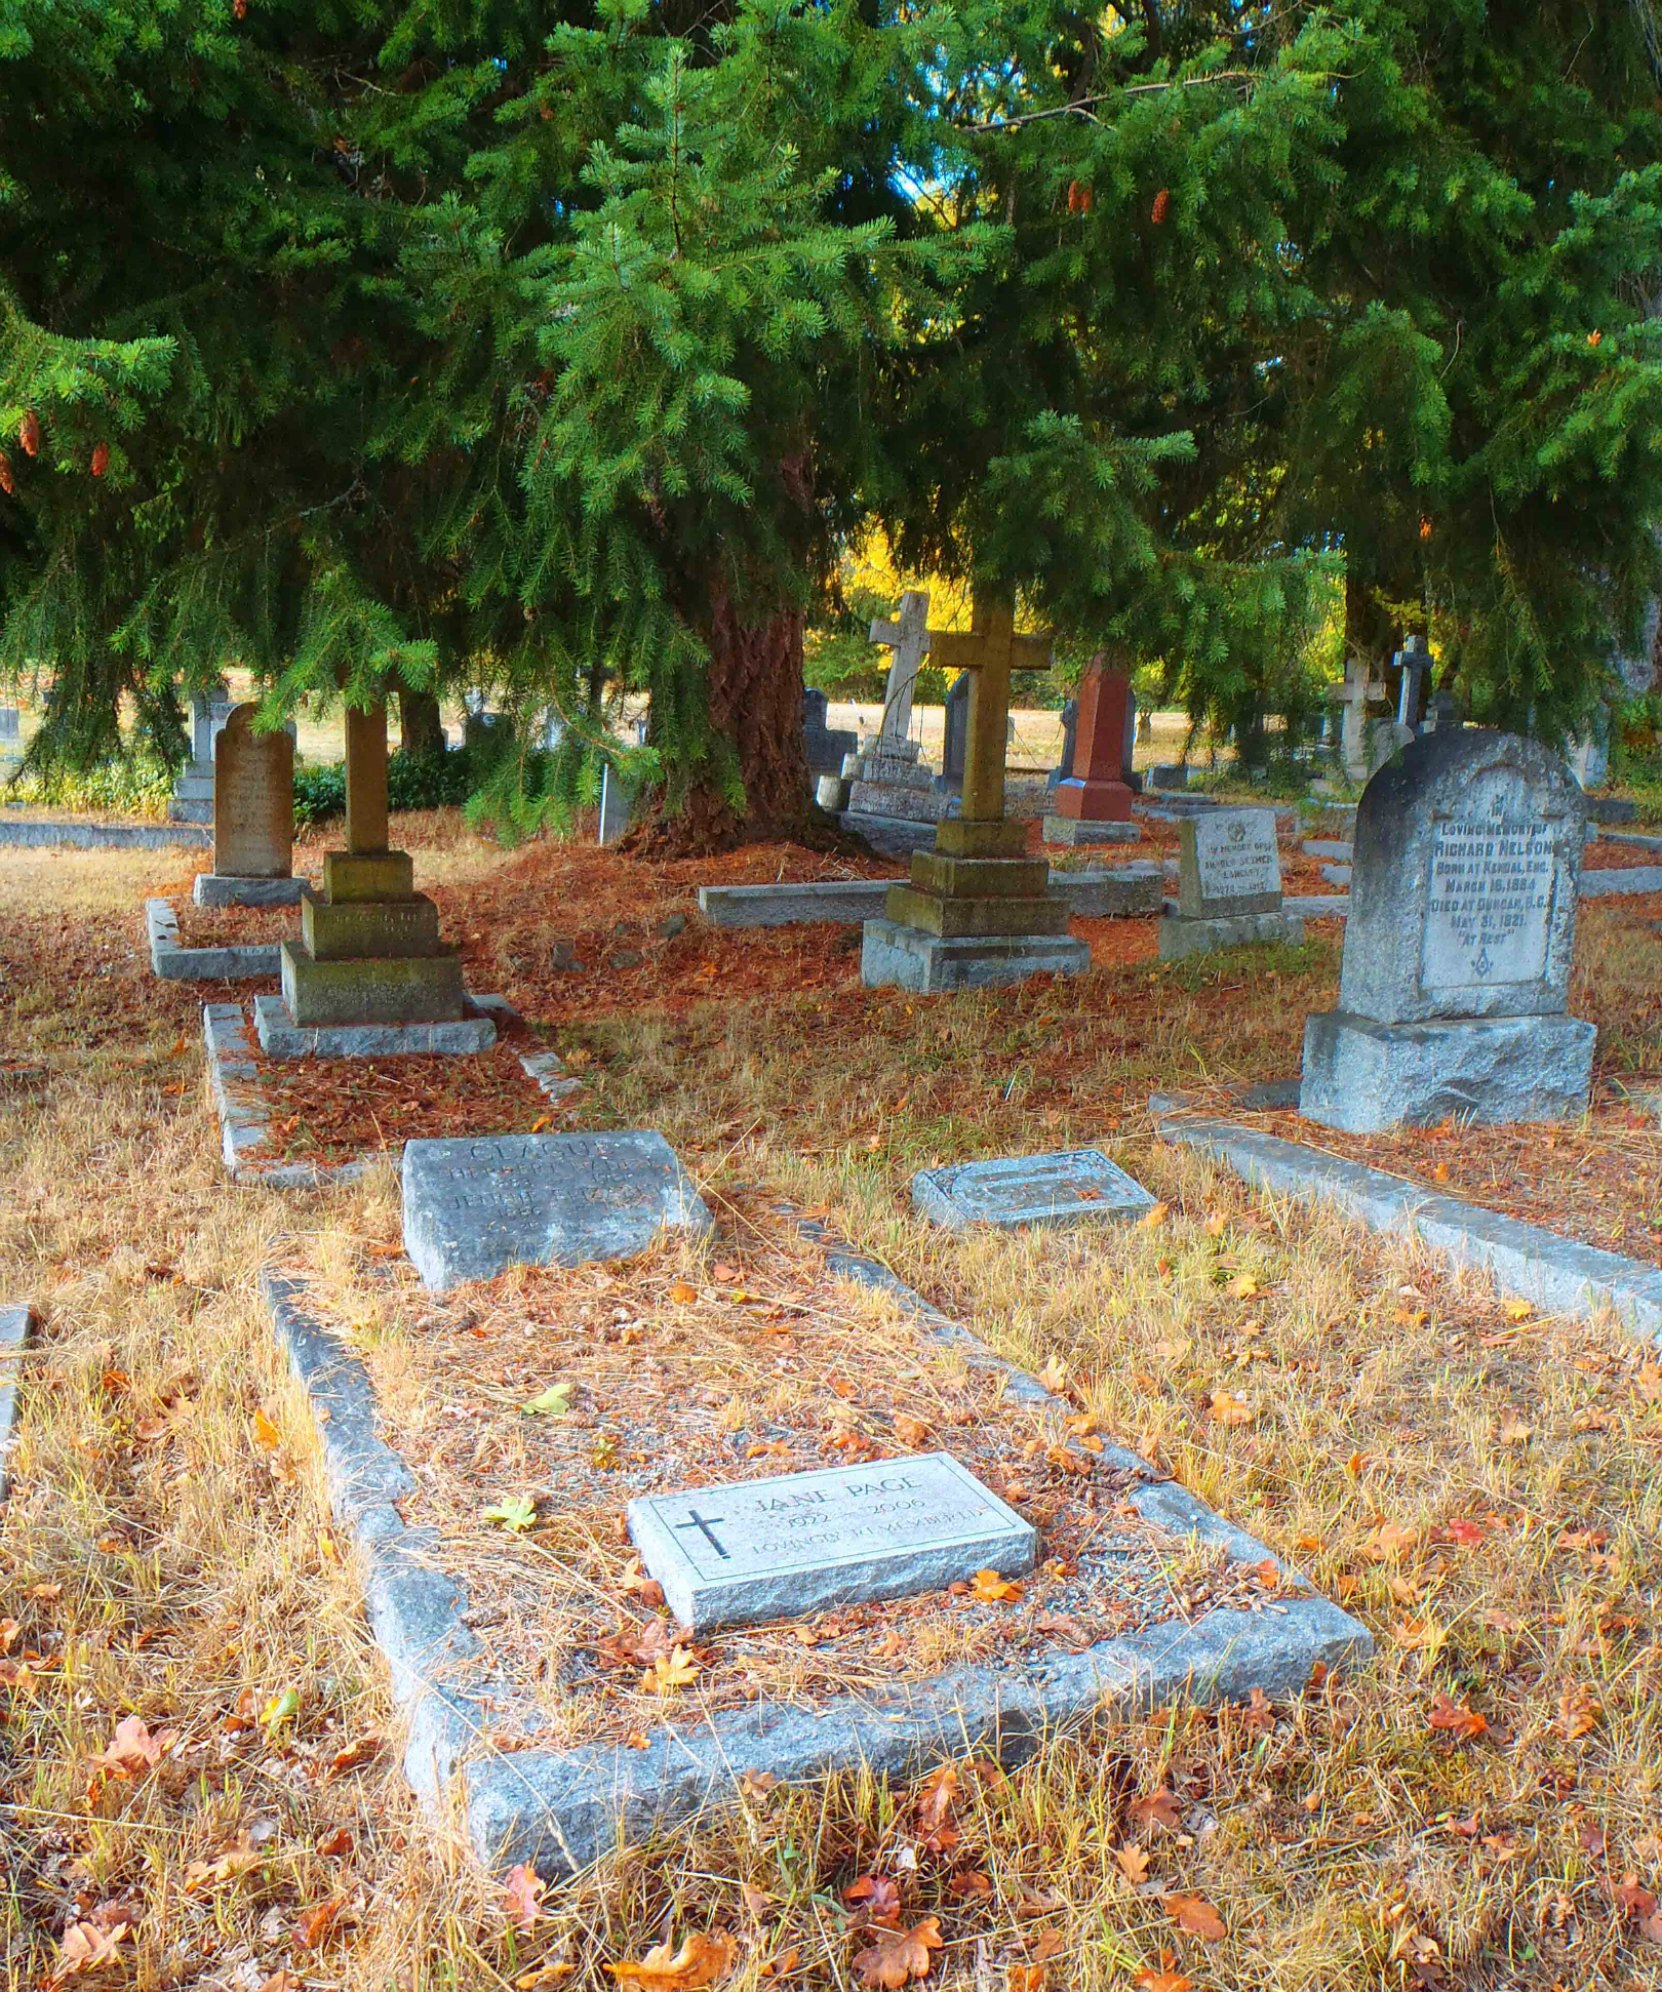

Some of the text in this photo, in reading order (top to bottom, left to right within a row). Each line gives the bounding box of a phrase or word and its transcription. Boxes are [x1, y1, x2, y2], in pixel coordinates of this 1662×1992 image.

[1441, 823, 1482, 836] LOVING
[1486, 823, 1531, 836] MEMORY
[1435, 840, 1552, 857] RICHARD NELSON
[1436, 861, 1465, 875] BORN
[1467, 863, 1480, 875] AT
[1445, 879, 1486, 893] MARCH
[1431, 899, 1459, 912] DIED
[1461, 899, 1475, 912] AT
[1451, 915, 1475, 928] MAY
[755, 1476, 922, 1512] JANE PAGE
[868, 1498, 926, 1515] 2006
[752, 1531, 840, 1554] LOVINGLY
